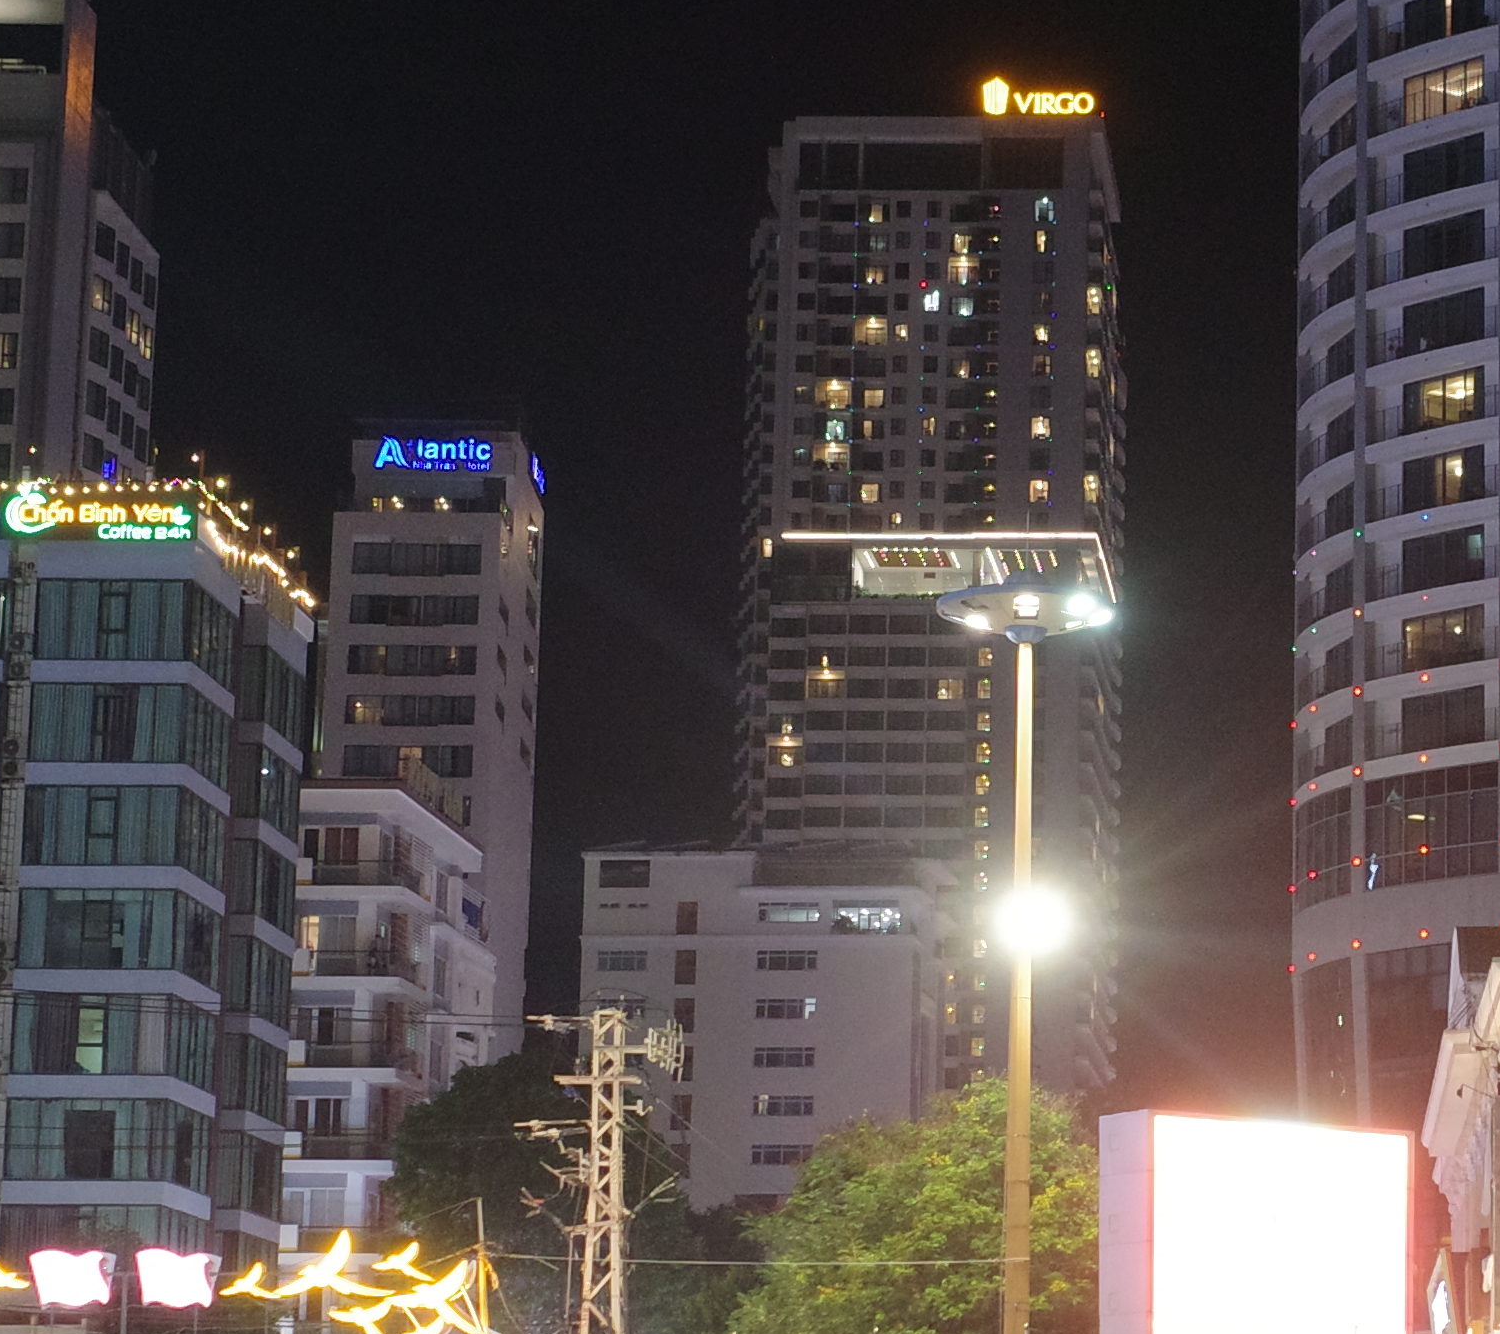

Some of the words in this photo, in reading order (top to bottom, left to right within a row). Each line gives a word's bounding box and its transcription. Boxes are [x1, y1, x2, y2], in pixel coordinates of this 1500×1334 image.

[1013, 91, 1095, 115] VIRGO
[18, 499, 74, 524] Chốn
[97, 524, 152, 540] Coffee
[154, 526, 191, 540] 24h
